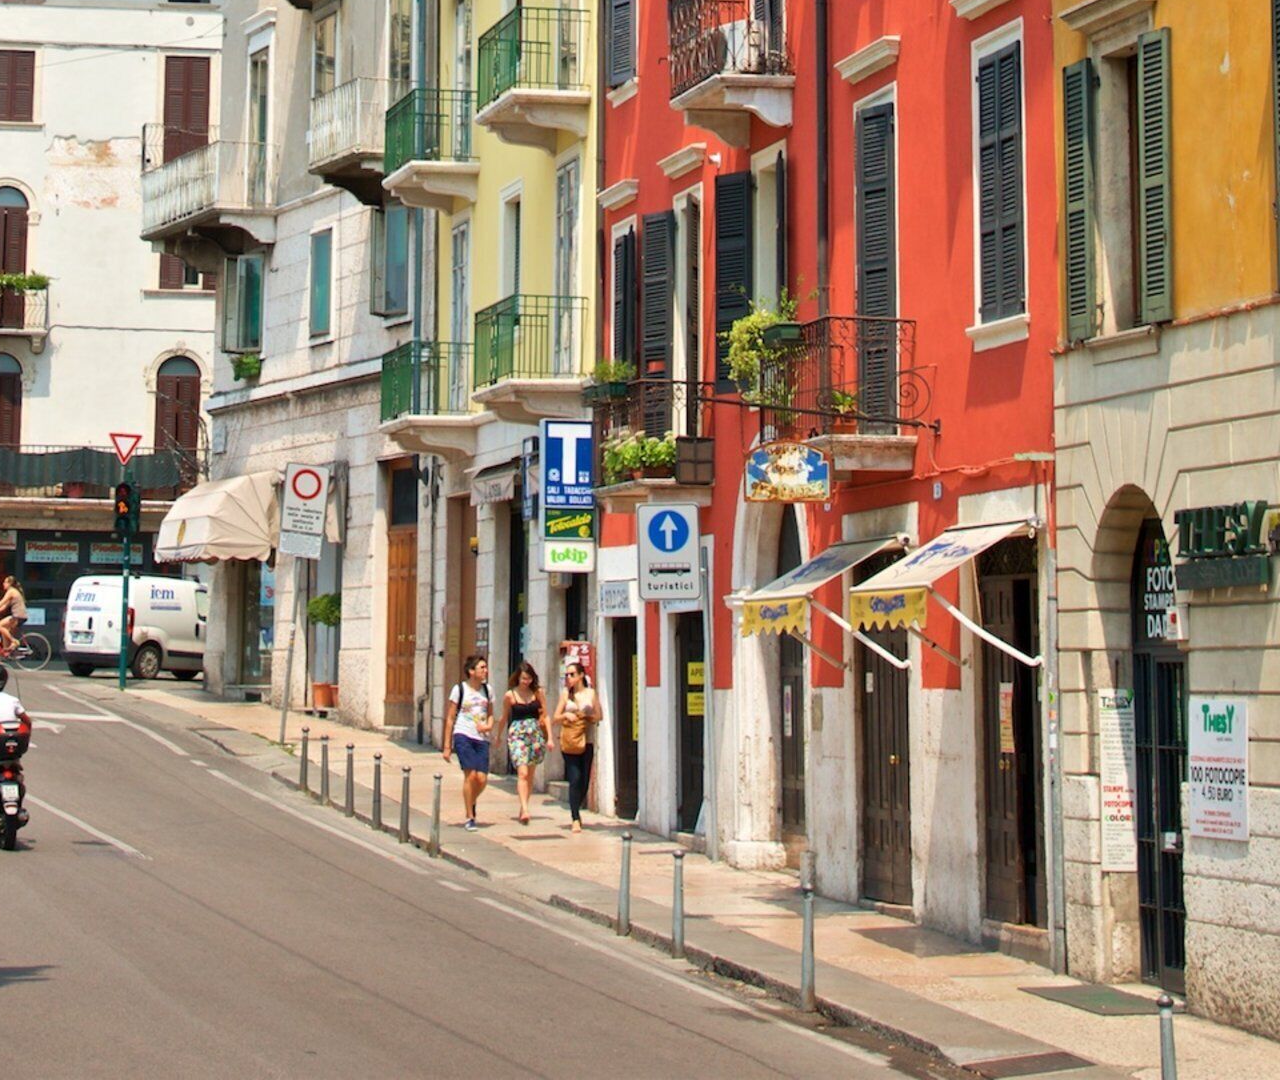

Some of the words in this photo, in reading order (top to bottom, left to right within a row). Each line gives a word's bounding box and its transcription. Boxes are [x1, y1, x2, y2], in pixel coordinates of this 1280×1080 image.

[547, 423, 592, 485] T
[1175, 500, 1268, 557] THESY
[550, 547, 587, 564] totip
[647, 581, 694, 591] turistici
[1205, 767, 1245, 785] FOTOCOPIE
